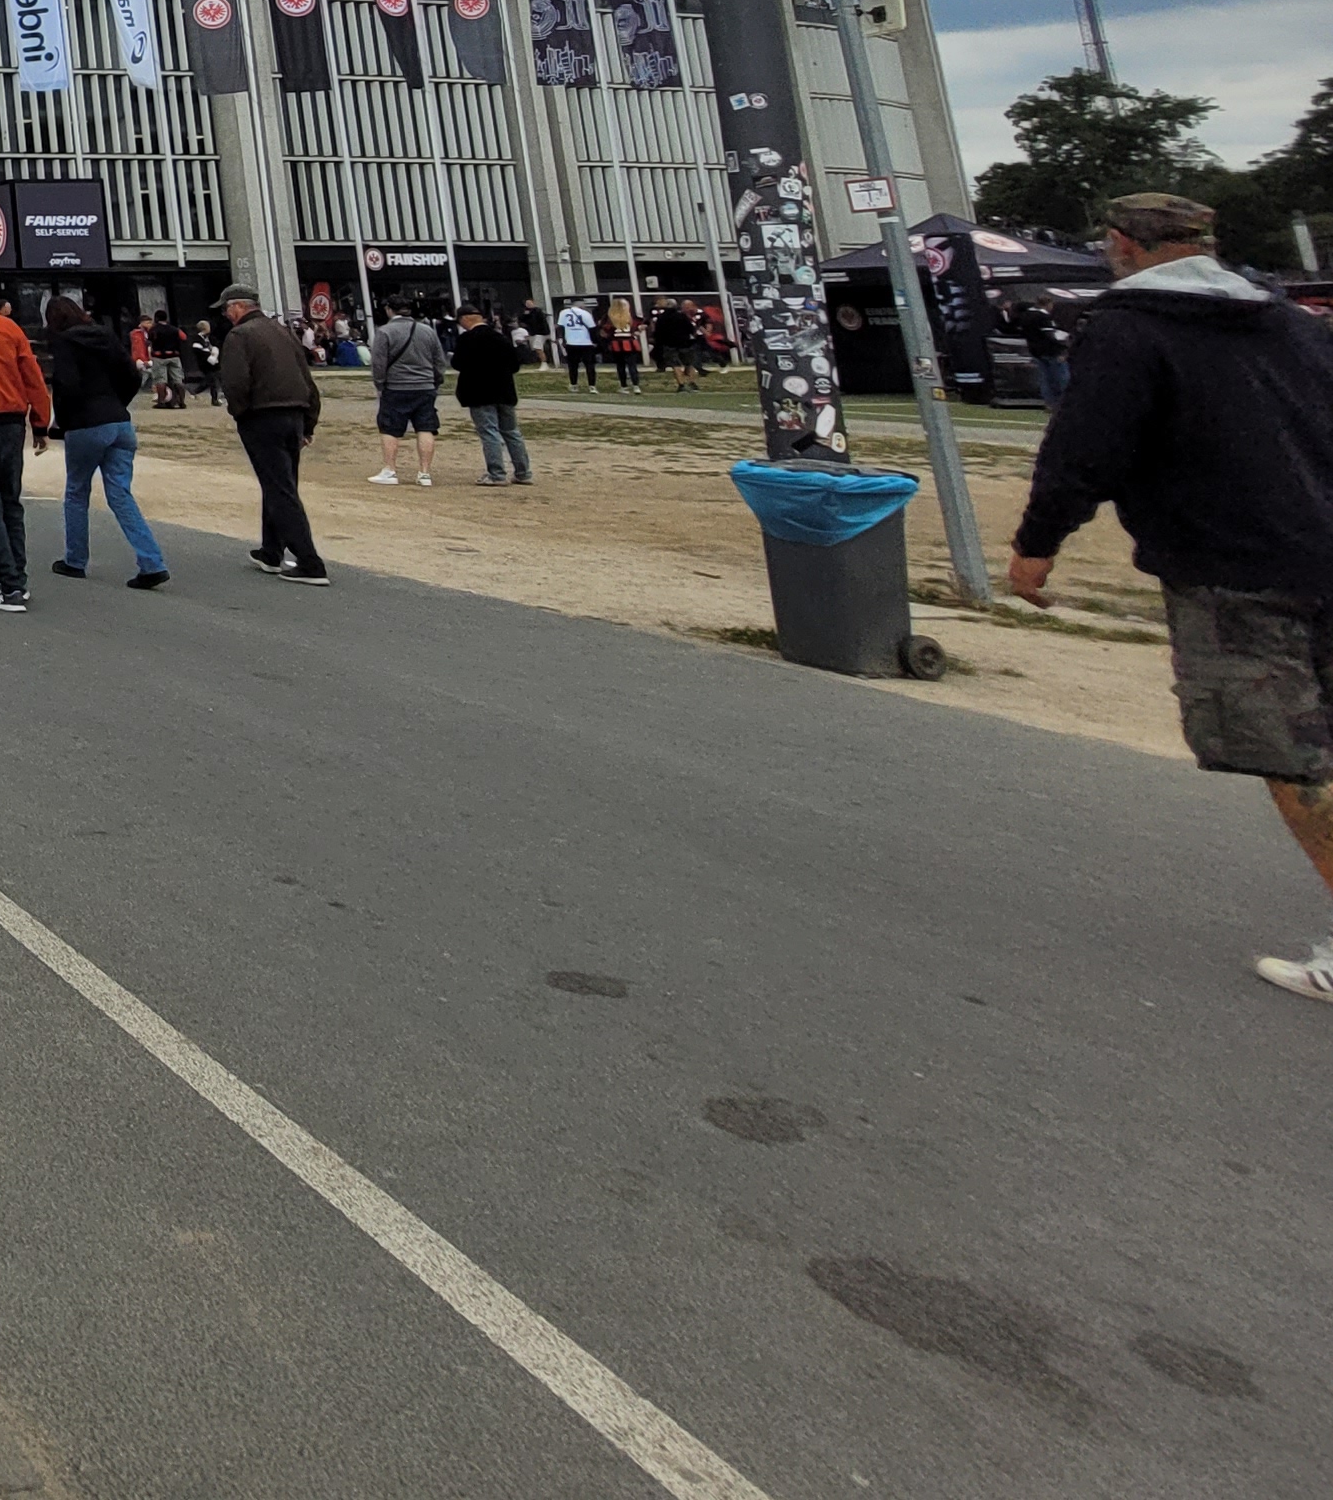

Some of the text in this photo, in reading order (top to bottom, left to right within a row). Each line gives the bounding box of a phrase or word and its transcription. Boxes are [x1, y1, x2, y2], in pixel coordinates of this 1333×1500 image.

[25, 215, 98, 226] FANSHOP
[35, 228, 90, 237] SELF-SERVICE
[236, 257, 250, 269] 05
[386, 253, 448, 266] FANSHOP
